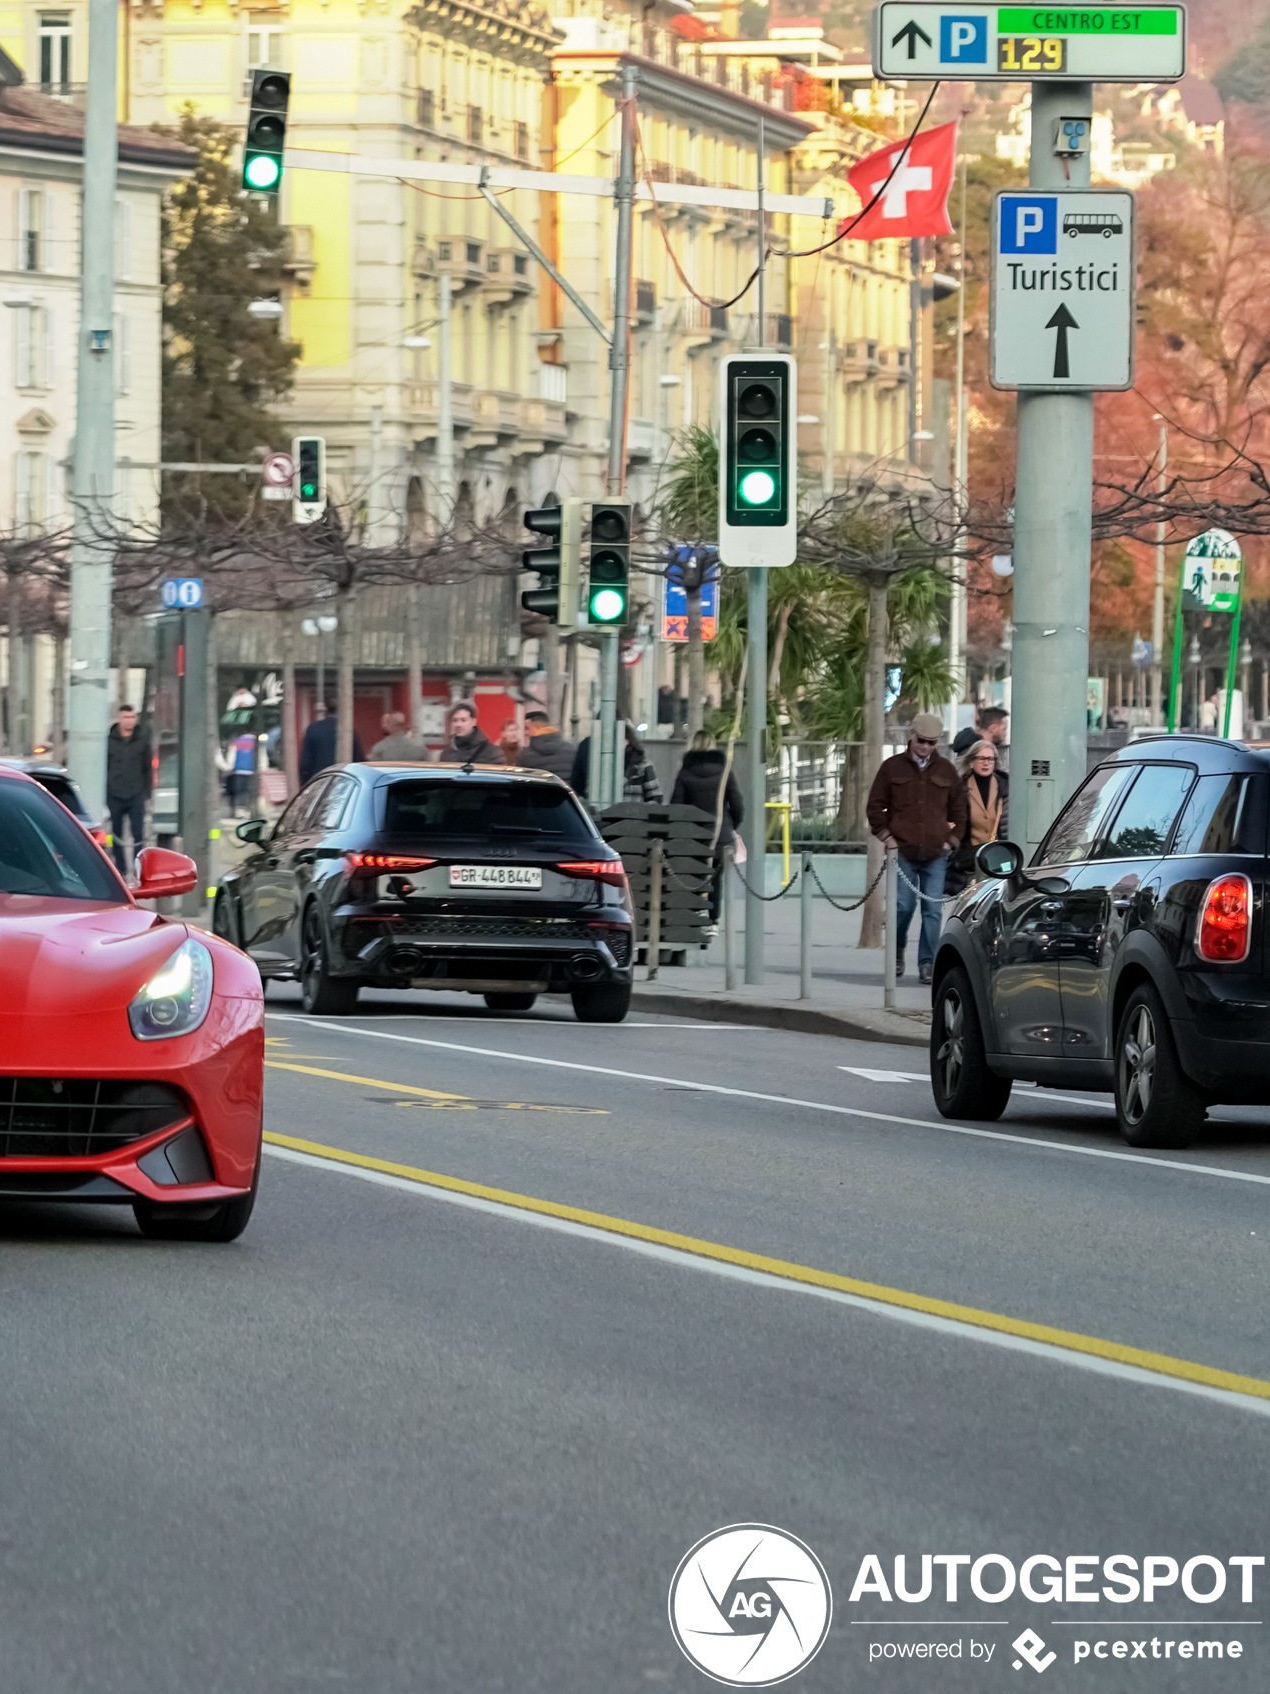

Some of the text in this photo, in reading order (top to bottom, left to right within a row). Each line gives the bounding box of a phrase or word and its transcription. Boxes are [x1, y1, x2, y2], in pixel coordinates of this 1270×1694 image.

[1033, 13, 1142, 30] CENTRO EST
[1001, 37, 1063, 71] 129
[1007, 263, 1118, 291] Turistici
